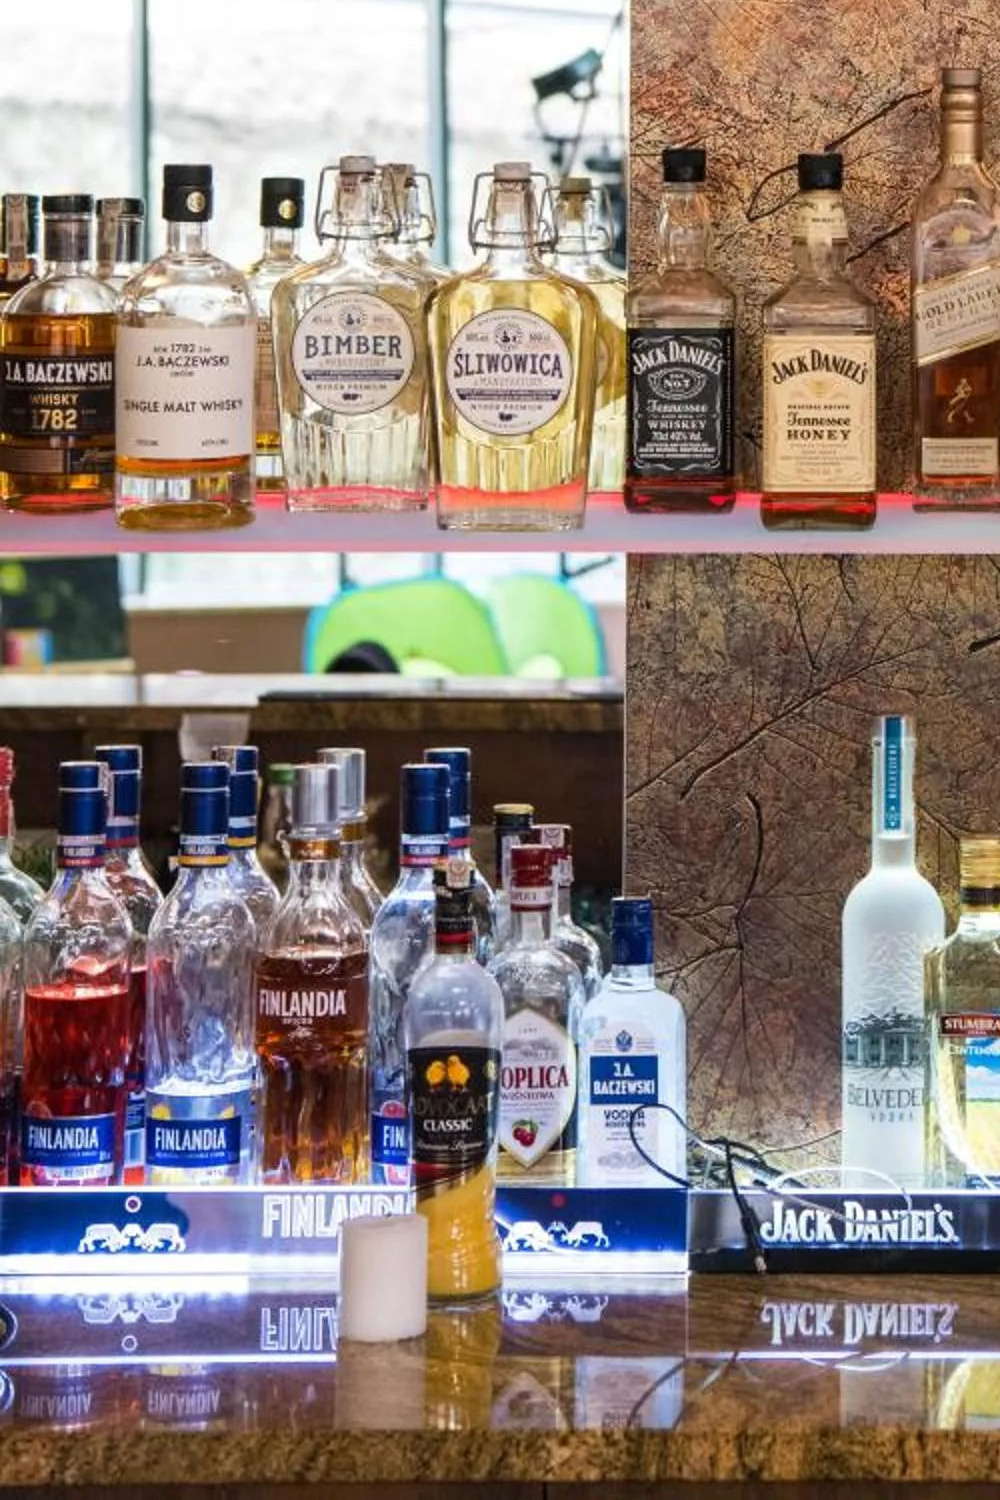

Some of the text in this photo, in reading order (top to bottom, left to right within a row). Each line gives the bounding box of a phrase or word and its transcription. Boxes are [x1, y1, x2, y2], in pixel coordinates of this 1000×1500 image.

[305, 335, 402, 359] BIMBER
[632, 340, 726, 376] JACK DANIEL'S
[5, 360, 113, 383] J.A. BACZEWSKI
[158, 355, 229, 368] BACZEWSKI
[453, 348, 563, 379] ŚLIWOWICA
[772, 348, 868, 385] JACK DANIEL'S
[31, 393, 80, 406] WHISKY
[163, 402, 197, 413] MALT
[200, 400, 243, 412] WHISKY
[32, 409, 78, 431] 1782
[647, 420, 708, 430] WHISKEY
[787, 411, 851, 427] Tennessee
[786, 429, 851, 442] HONEY
[259, 988, 347, 1017] FINLANDIA
[501, 1065, 569, 1091] OPLICA
[592, 1080, 656, 1096] BACZEWSKI
[848, 1083, 923, 1109] BELVEDE
[423, 1118, 473, 1133] CLASSIC
[28, 1125, 99, 1150] FINLANDIA
[155, 1127, 227, 1151] FINLANDIA
[760, 1200, 960, 1243] JACK DANIEL'S
